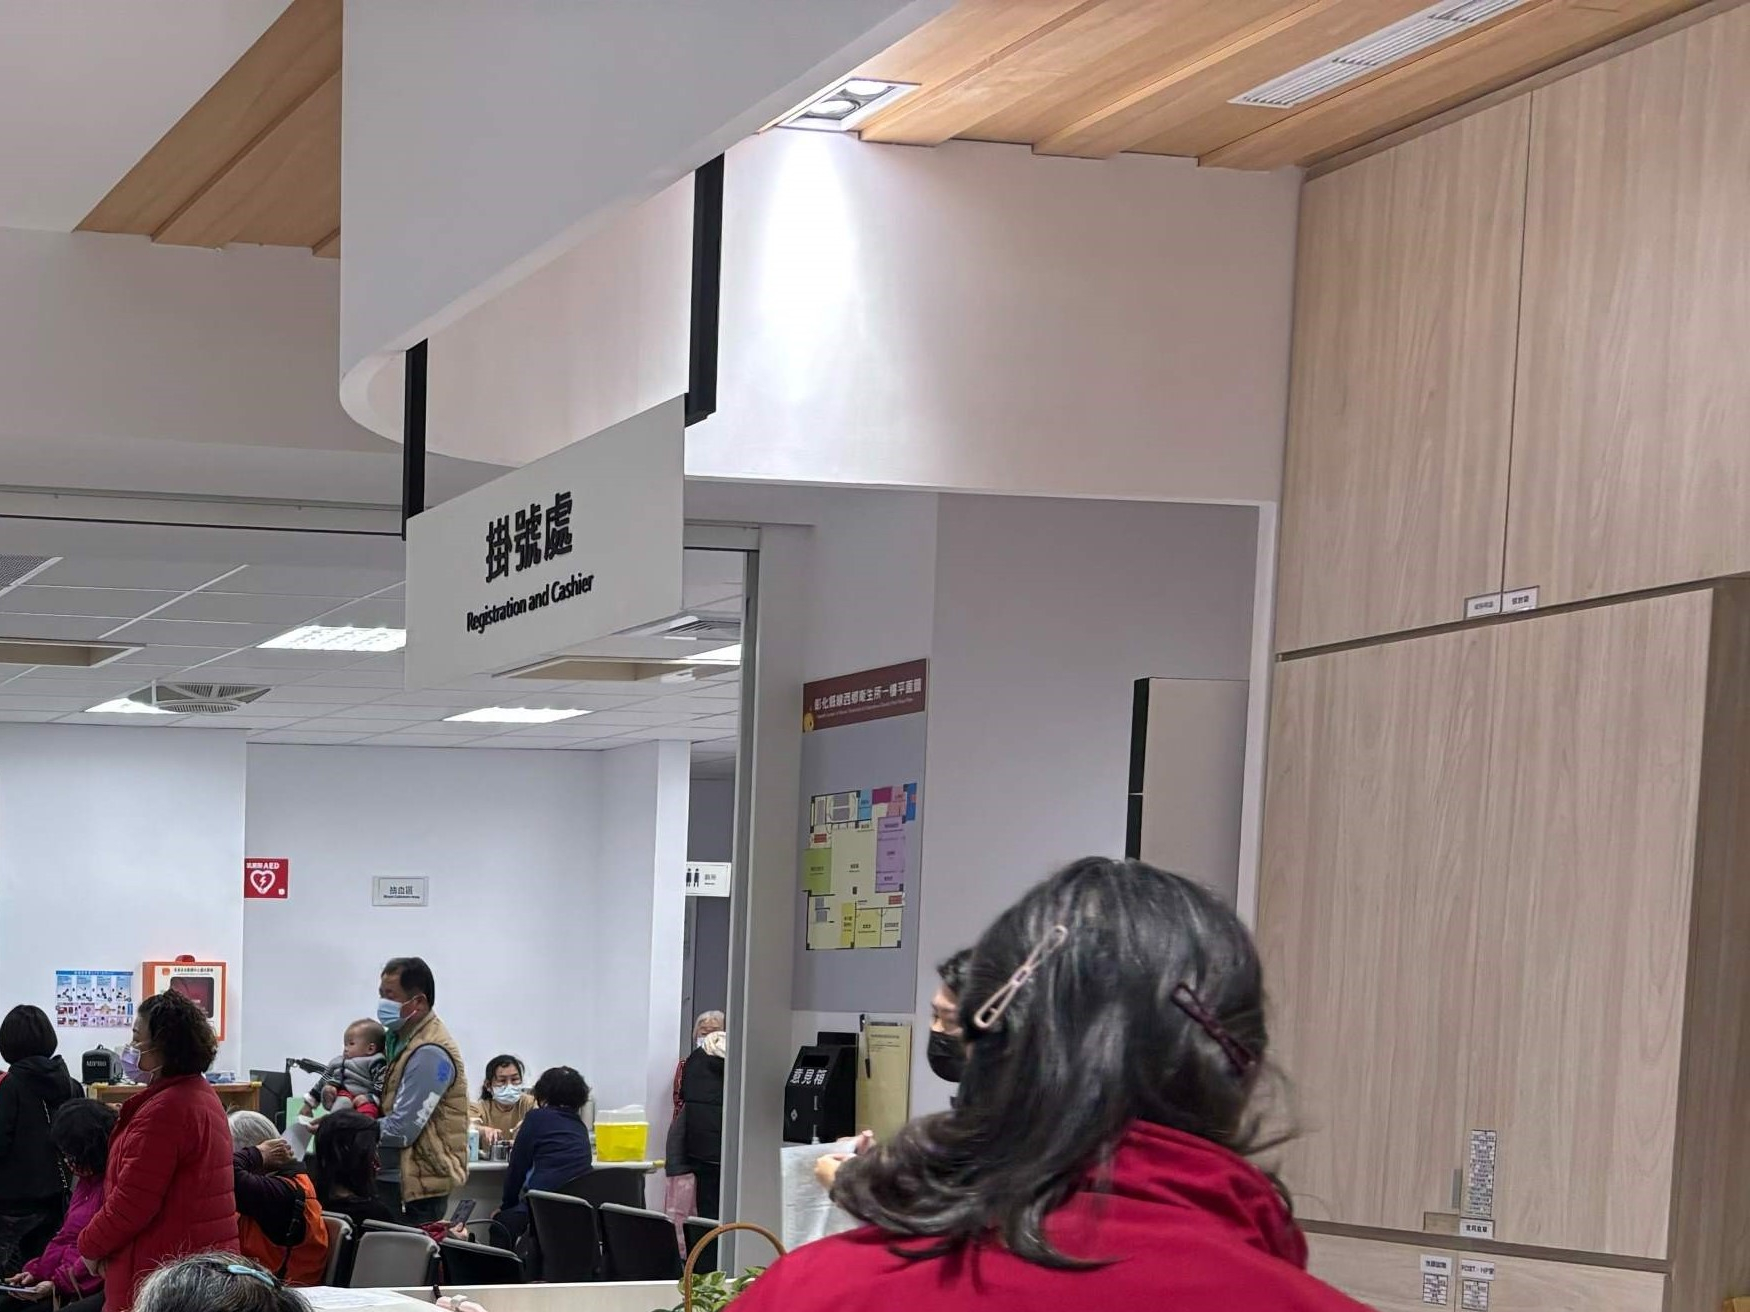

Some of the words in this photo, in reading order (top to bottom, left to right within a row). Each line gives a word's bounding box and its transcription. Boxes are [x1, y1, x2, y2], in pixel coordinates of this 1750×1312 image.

[486, 491, 572, 583] 掛號處
[467, 597, 526, 634] Registration
[528, 584, 549, 611] and
[551, 572, 594, 603] Cashier
[790, 1068, 828, 1085] 意見箱
